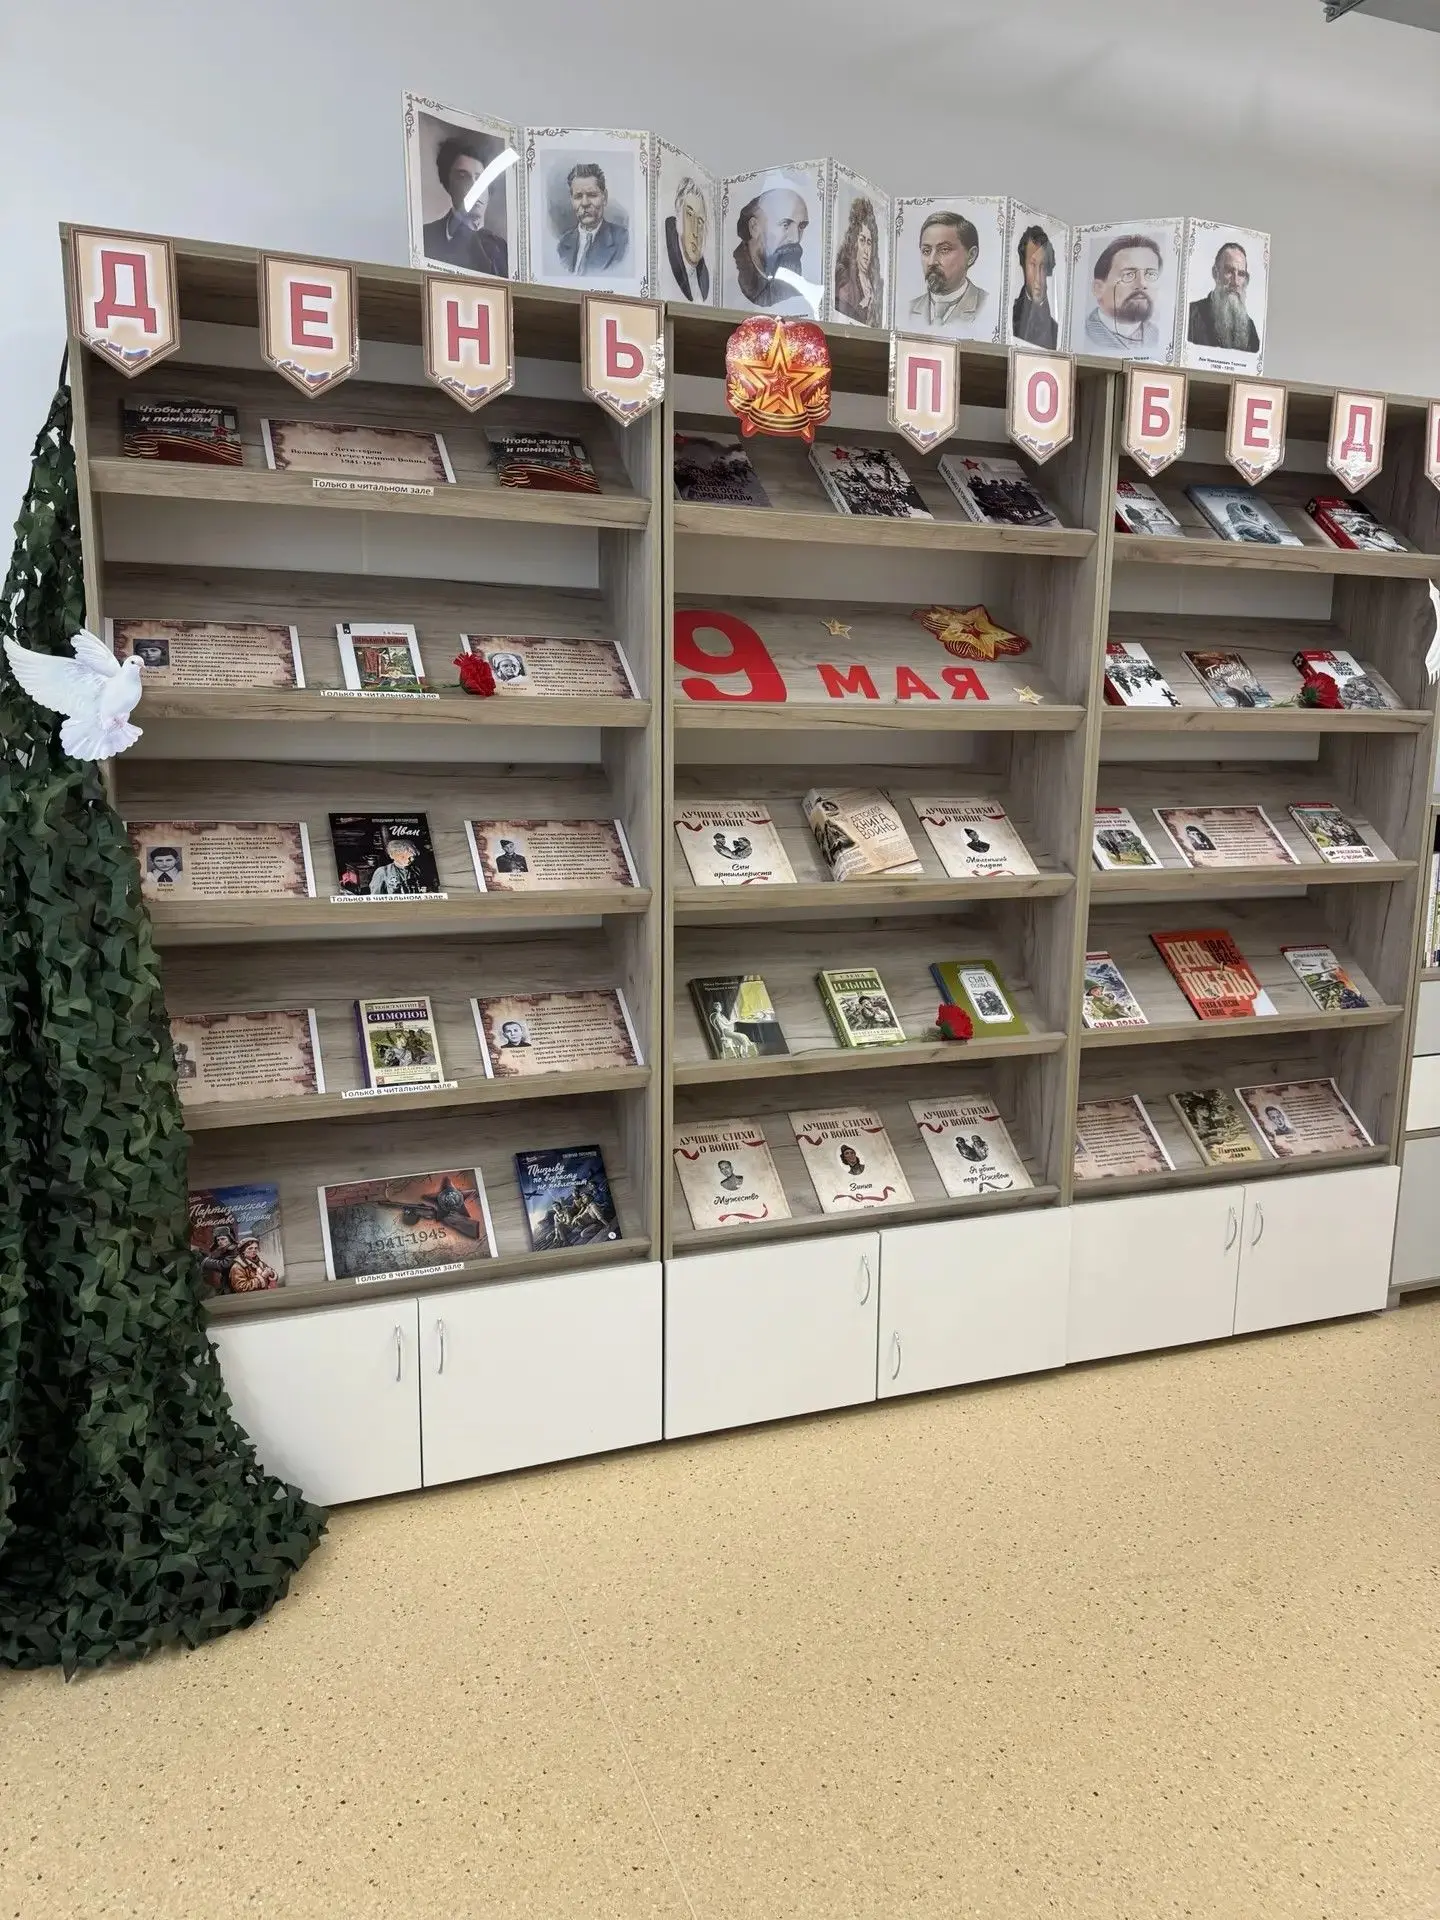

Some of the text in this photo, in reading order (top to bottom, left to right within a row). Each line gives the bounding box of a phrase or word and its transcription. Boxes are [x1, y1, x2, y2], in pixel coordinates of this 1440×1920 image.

[139, 405, 223, 415] Чтобы знали
[152, 415, 213, 423] помнили
[502, 437, 537, 445] Чтобы
[313, 479, 347, 489] Только
[357, 483, 408, 493] читальном
[410, 487, 433, 495] зале.
[674, 609, 787, 702] 9
[818, 663, 989, 701] МАЯ
[681, 810, 760, 819] ЛУЧШИЕ СТИХИ
[851, 805, 882, 824] ДЕТСКАЯ
[925, 806, 995, 815] ЛУЧШИЕ СТИХИ
[702, 818, 745, 827] О ВОЙНЕ
[853, 812, 891, 832] КНИГА
[389, 825, 420, 837] Иван
[860, 820, 899, 840] ВОЙНЫ
[1163, 940, 1214, 973] ДЕНЬ
[1181, 968, 1260, 1001] ПОБЕДЫ
[368, 1010, 427, 1021] СИМОНОВ
[1093, 1018, 1146, 1028] СЫН ПОЛКА
[343, 1089, 374, 1098] Только
[384, 1084, 431, 1094] читальном
[922, 1106, 990, 1120] ЛУЧШИЕ СТИХИ
[802, 1117, 873, 1132] ЛУЧШИЕ СТИХИ
[950, 1116, 980, 1127] ВОЙНЕ
[680, 1131, 755, 1146] ЛУЧШИЕ СТИХИ
[830, 1128, 861, 1139] ВОЙНЕ
[709, 1142, 742, 1153] ВОЙНЕ
[527, 1162, 565, 1176] Призыву
[969, 1165, 977, 1175] Я
[713, 1192, 759, 1205] Мужество
[189, 1200, 268, 1219] Партизанское
[194, 1215, 235, 1229] детство
[366, 1227, 447, 1253] 1941-1945
[357, 1274, 387, 1283] Только
[395, 1267, 441, 1278] читальном
